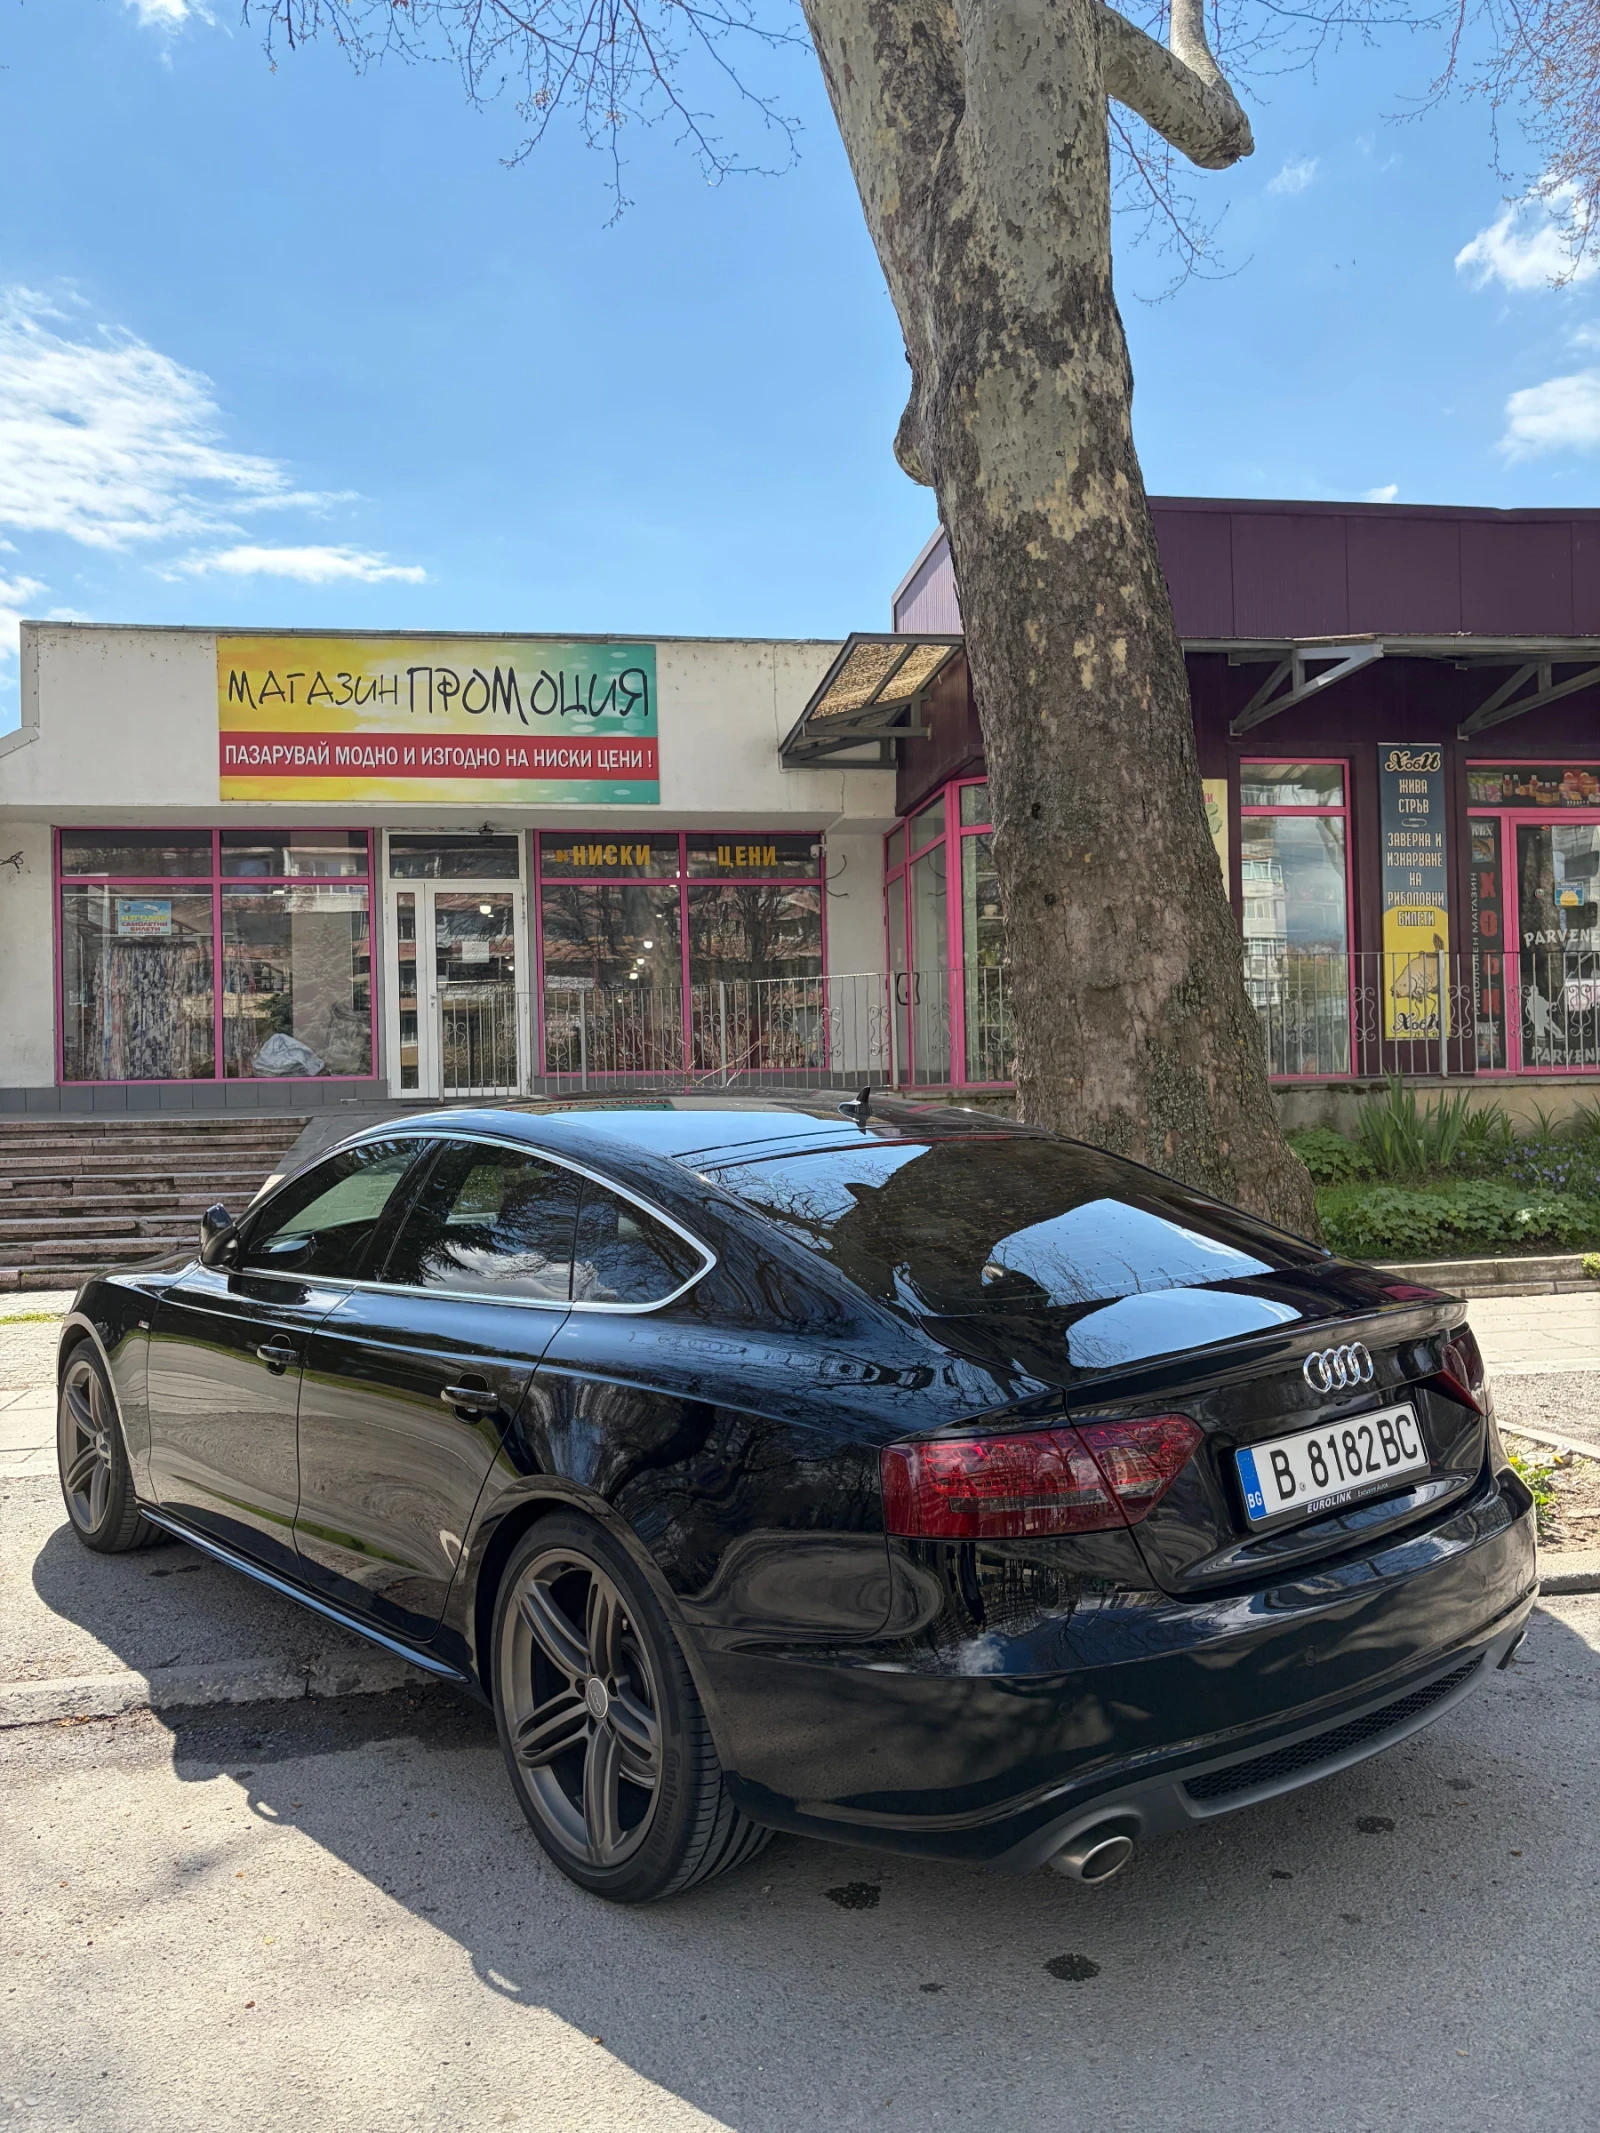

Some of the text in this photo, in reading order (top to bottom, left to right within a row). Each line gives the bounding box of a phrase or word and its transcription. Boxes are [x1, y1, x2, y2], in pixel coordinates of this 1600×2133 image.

[228, 665, 649, 725] МАГАЗИН ПРОМОЦИЯ
[225, 741, 330, 766] ПАЗАРУВАЙ
[336, 745, 398, 767] МОДНО
[403, 747, 417, 766] И
[420, 747, 501, 769] ИЗГОДНО
[506, 748, 530, 767] НА
[533, 749, 592, 768] НИСКИ
[1399, 779, 1428, 794] ЖИВА
[1398, 798, 1429, 813] СТРЪВ
[1387, 832, 1442, 847] ЗАВЕРКА И
[573, 844, 777, 868] НИСКИ ЦЕНИ
[1387, 852, 1443, 867] ИЗКАРВАНЕ
[1409, 872, 1422, 887] НА
[1387, 891, 1444, 907] РИБОЛОВНИ
[1470, 873, 1478, 933] МАГАЗИН
[1398, 911, 1435, 926] БИЛЕТИ
[1247, 1492, 1263, 1508] BG
[1307, 1490, 1352, 1513] EUROLINK
